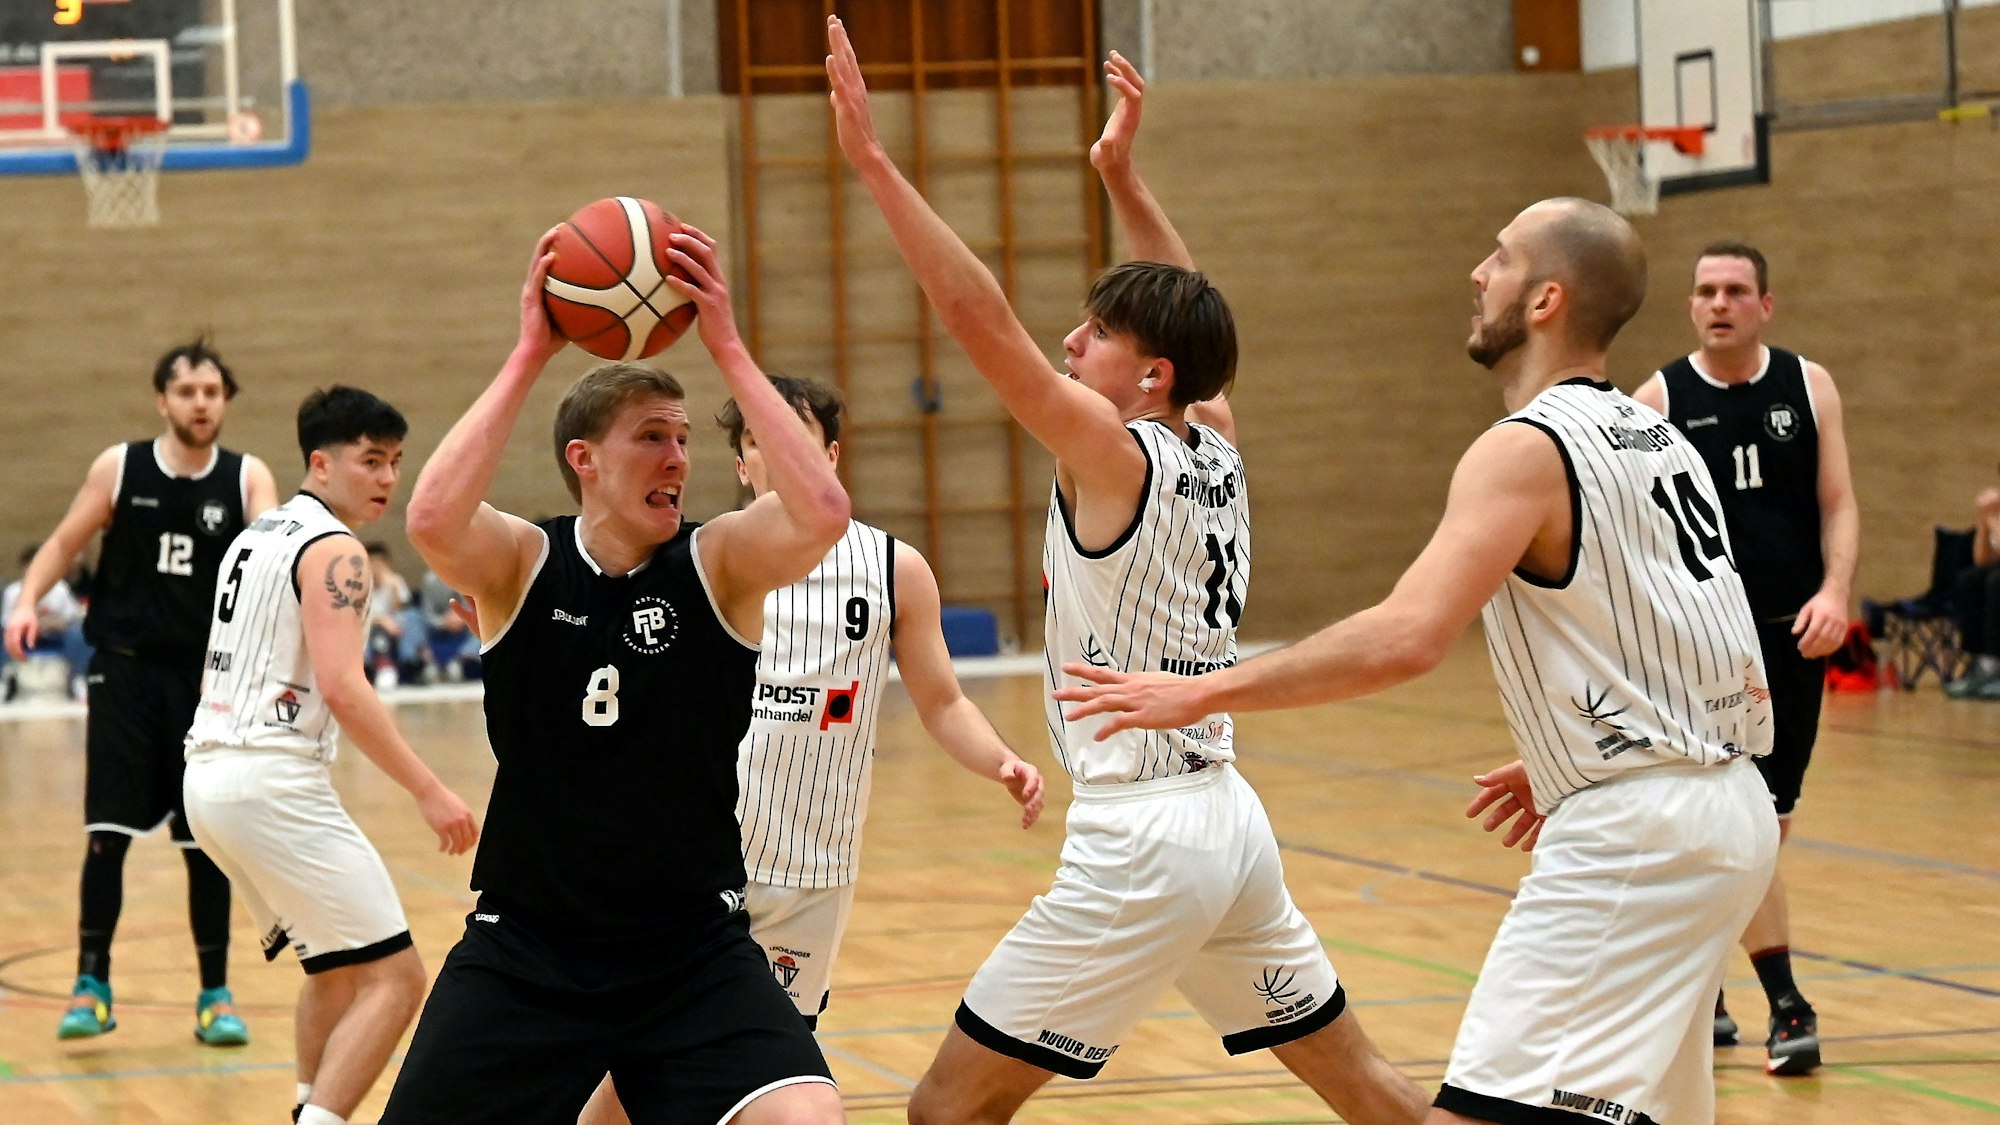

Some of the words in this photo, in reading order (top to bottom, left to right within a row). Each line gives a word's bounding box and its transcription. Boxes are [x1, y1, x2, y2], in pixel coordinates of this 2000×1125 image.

[1732, 443, 1764, 490] 11
[1651, 471, 1736, 583] 14
[156, 531, 194, 576] 12
[218, 548, 253, 623] 5
[1203, 533, 1242, 629] 11
[845, 597, 870, 641] 9
[582, 664, 620, 726] 8
[759, 684, 820, 705] POST
[1593, 1098, 1624, 1121] DER
